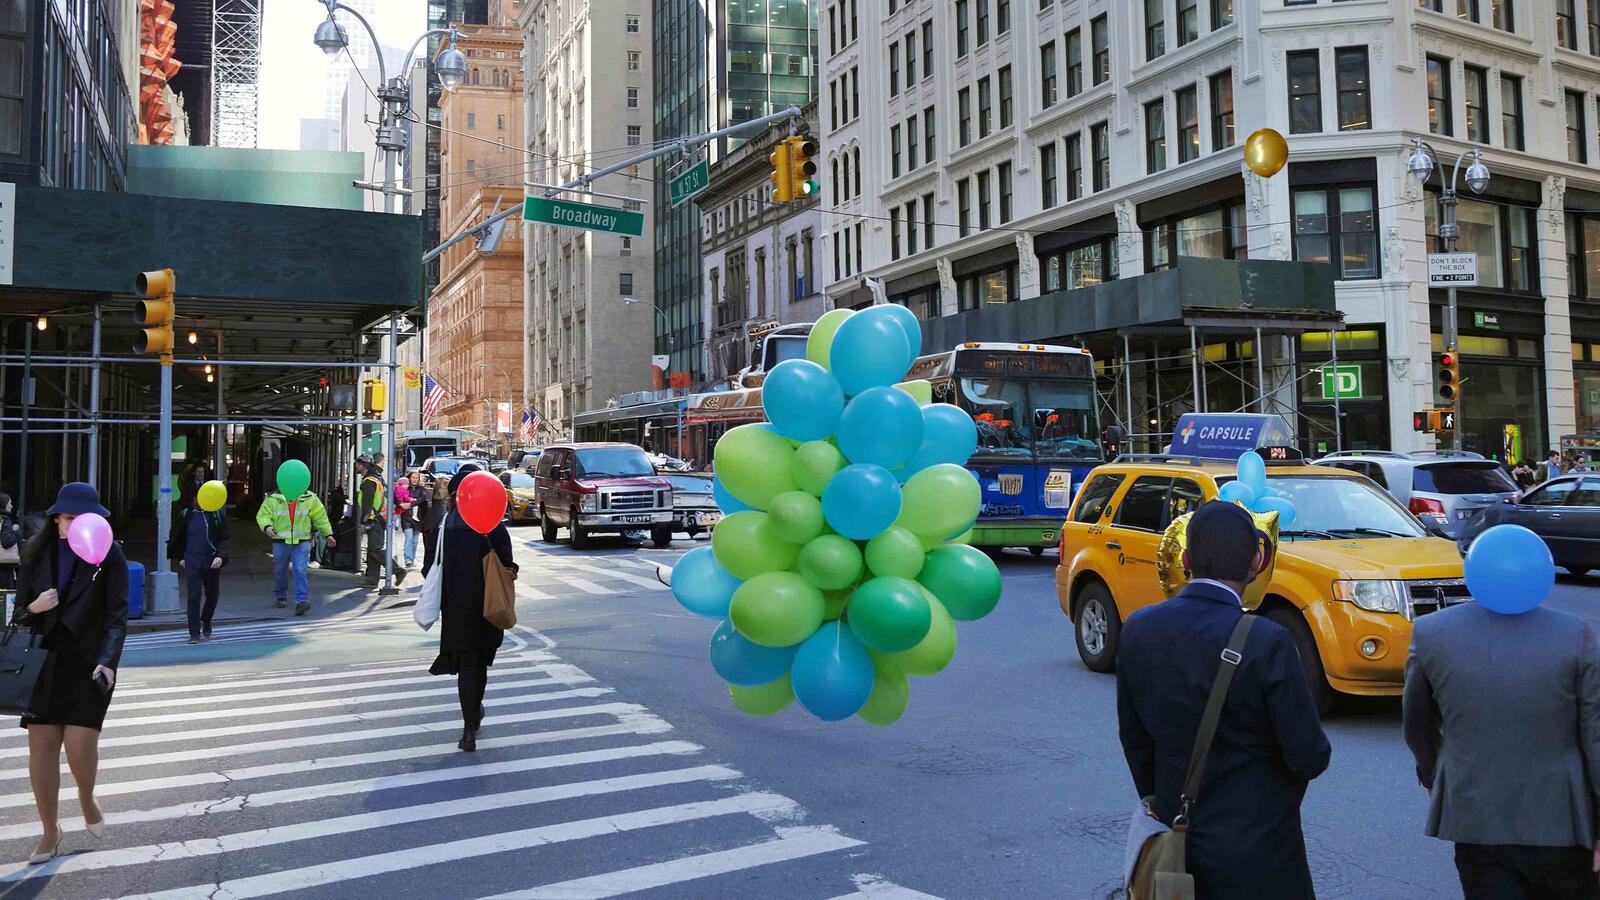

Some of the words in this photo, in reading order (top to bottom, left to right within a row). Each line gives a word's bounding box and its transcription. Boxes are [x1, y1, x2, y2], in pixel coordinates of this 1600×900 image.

[678, 180, 684, 197] W
[692, 170, 700, 188] St
[552, 205, 617, 231] Broadway
[1326, 372, 1357, 392] TD
[1200, 427, 1253, 440] CAPSULE
